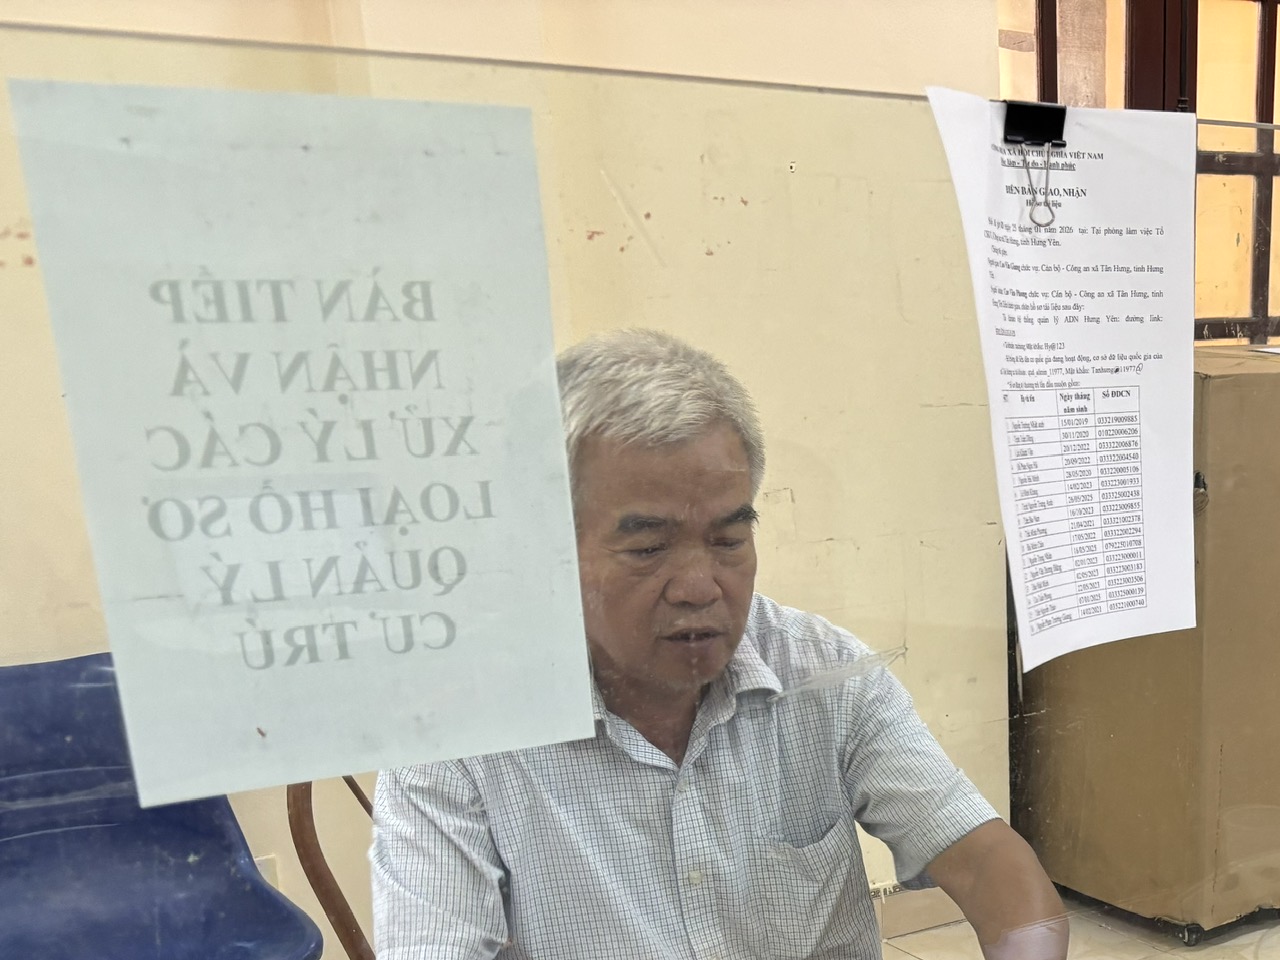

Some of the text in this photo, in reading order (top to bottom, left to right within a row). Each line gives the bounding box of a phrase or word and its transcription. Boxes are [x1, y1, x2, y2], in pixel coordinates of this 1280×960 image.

[1087, 152, 1104, 160] NAM
[1063, 187, 1087, 199] NHẬN
[1104, 227, 1123, 236] phòng
[1140, 227, 1152, 236] việc
[1066, 264, 1081, 273] Công
[1147, 265, 1164, 274] Hưng
[1080, 290, 1095, 299] Công
[1064, 315, 1079, 323] ADN
[1084, 315, 1100, 325] Hưng
